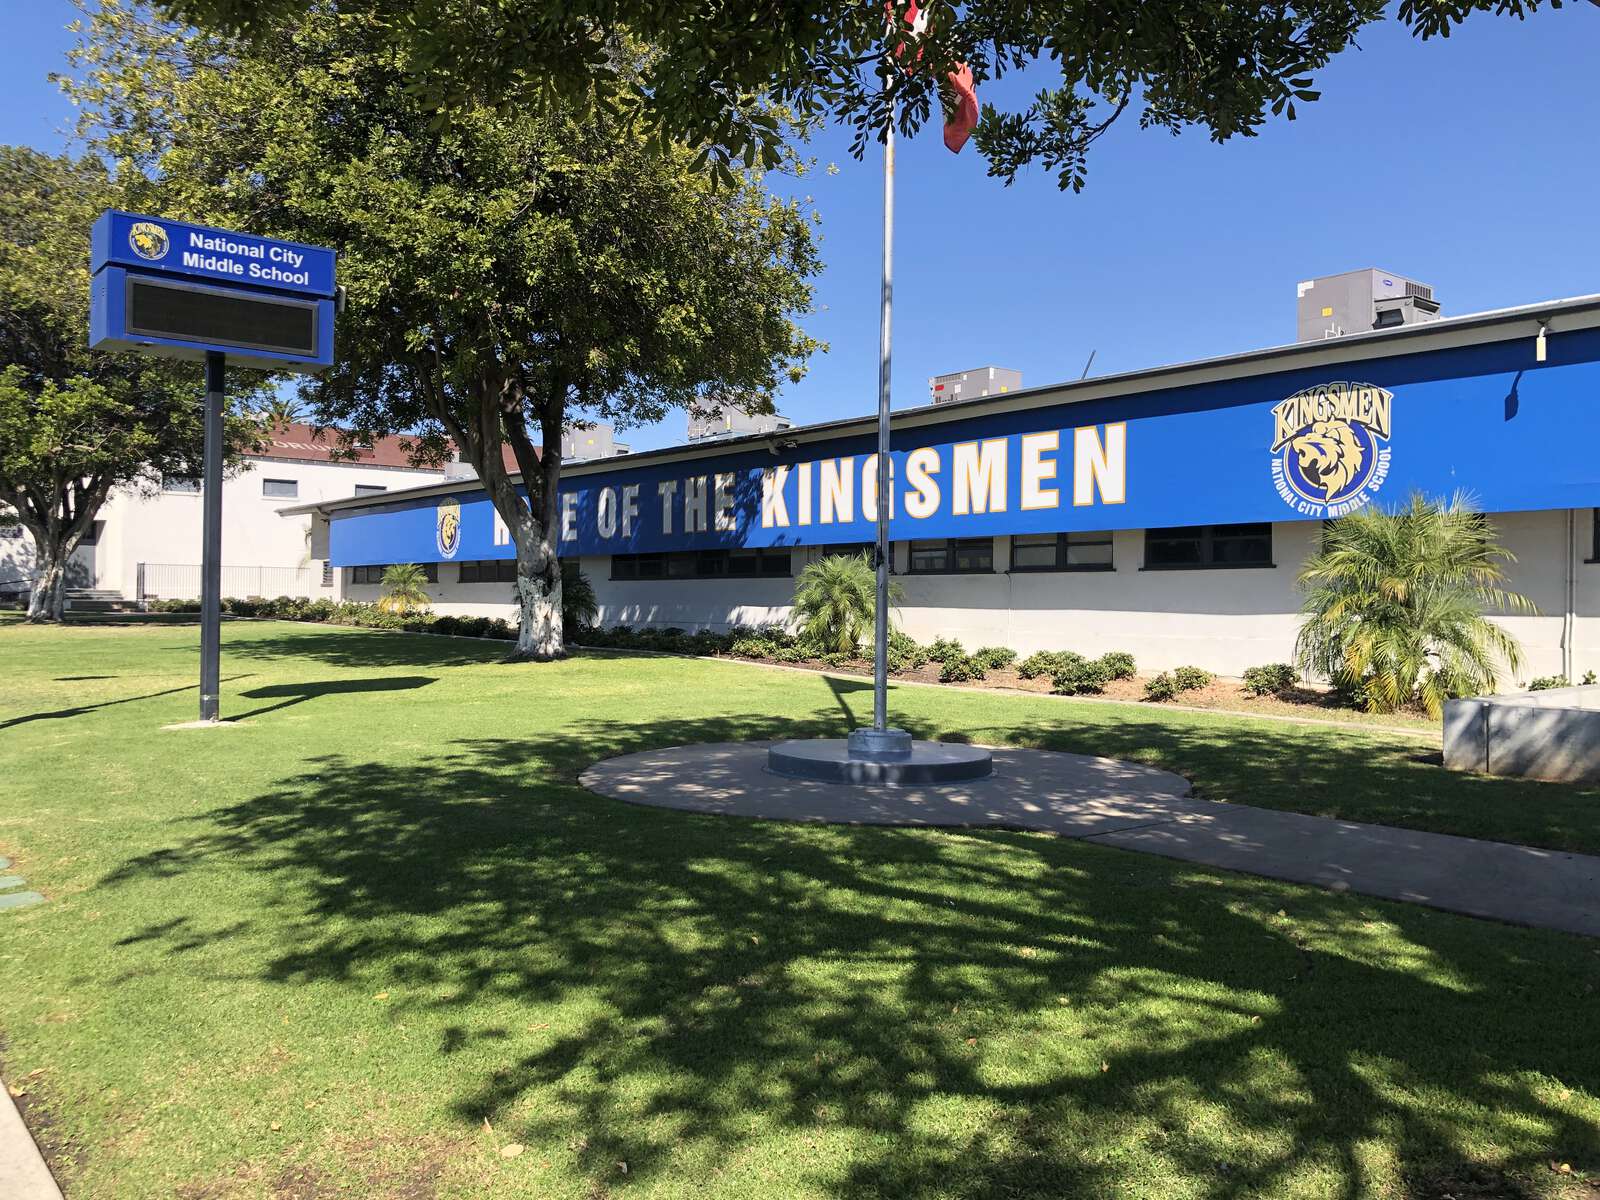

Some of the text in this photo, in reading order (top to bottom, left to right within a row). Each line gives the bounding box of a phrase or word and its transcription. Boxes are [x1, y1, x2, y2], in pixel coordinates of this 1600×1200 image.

[183, 252, 309, 286] Middle School
[190, 232, 265, 259] National
[269, 247, 304, 268] City
[1271, 381, 1393, 453] KINGSMEN
[597, 483, 640, 539] OF
[658, 472, 737, 534] THE
[762, 421, 1127, 529] KINGSMEN
[1271, 446, 1392, 518] NATIONAL CITY MIDDLE SCHOOL
